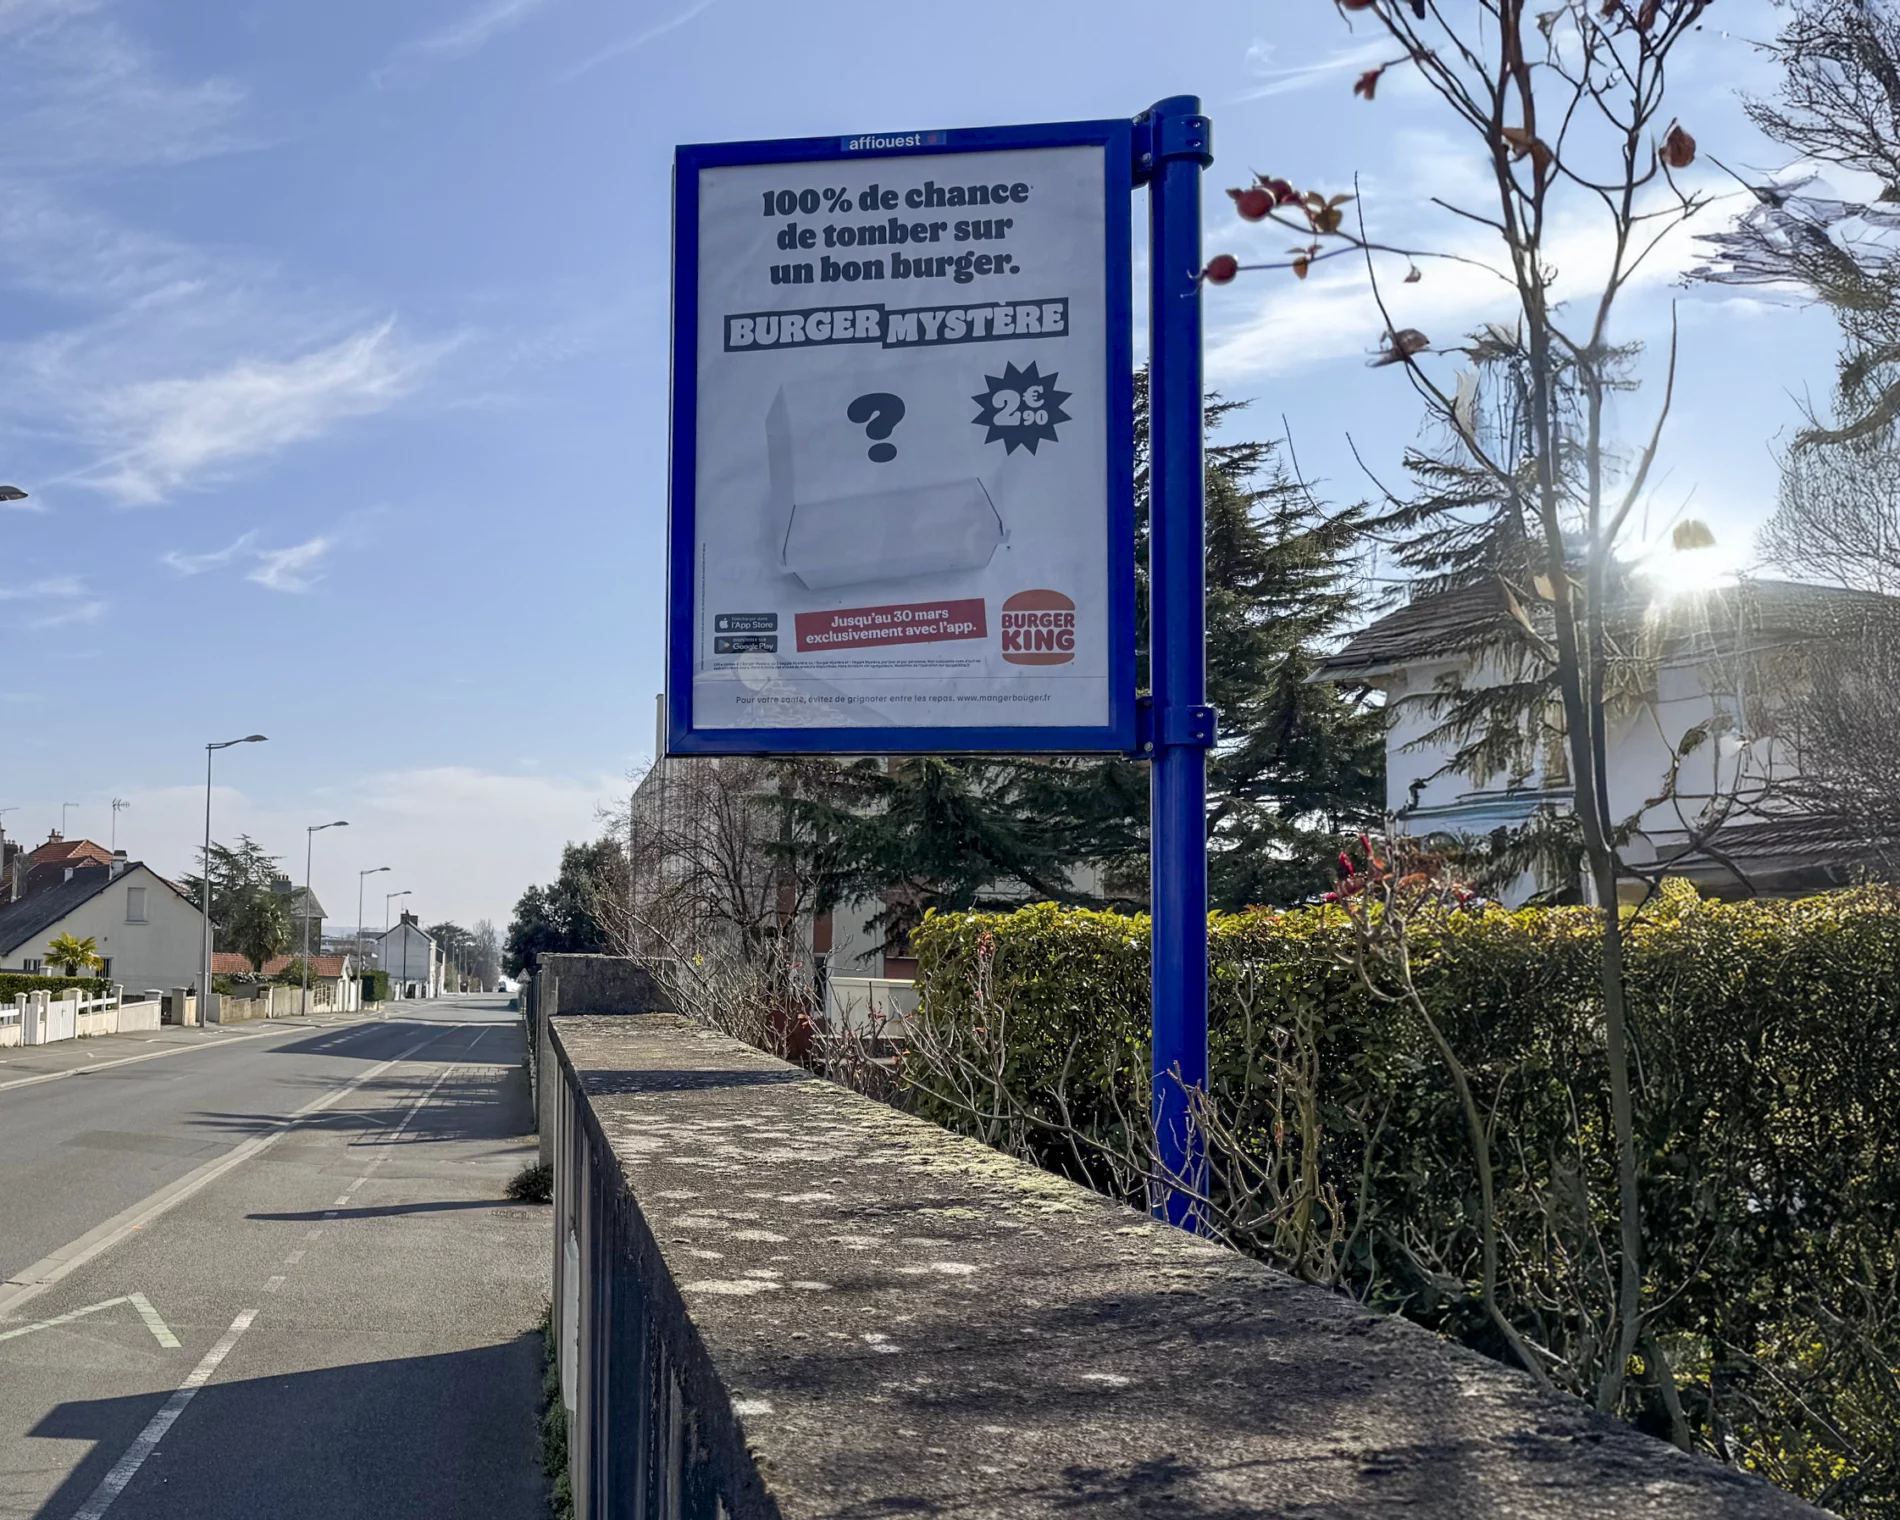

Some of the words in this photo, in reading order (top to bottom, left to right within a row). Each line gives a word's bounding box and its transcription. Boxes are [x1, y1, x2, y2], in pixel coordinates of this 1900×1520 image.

[849, 133, 921, 150] affiouest
[762, 186, 853, 216] 100%
[858, 184, 899, 211] de
[776, 222, 817, 250] de
[822, 217, 948, 248] tomber
[953, 218, 1014, 242] sur
[770, 262, 814, 285] un
[820, 255, 885, 282] bon
[890, 250, 1021, 284] burger.
[729, 309, 881, 347] BURGER
[886, 301, 1065, 343] MYSTÈRE
[752, 621, 773, 629] Store
[831, 612, 892, 628] Jusqu'au
[893, 610, 913, 623] 30
[914, 609, 949, 620] mars
[1001, 612, 1075, 629] BURGER
[805, 627, 903, 644] exclusivement
[905, 624, 937, 636] avec
[1001, 628, 1075, 652] KING
[732, 642, 758, 651] Google
[758, 642, 774, 650] Play
[736, 696, 754, 704] Pour
[808, 695, 833, 703] évitez
[834, 694, 845, 703] de
[847, 694, 887, 705] grignoter
[890, 694, 912, 702] entre
[914, 694, 926, 702] les
[928, 694, 955, 704] repas.
[957, 694, 1051, 703] www.mangerbouger.fr
